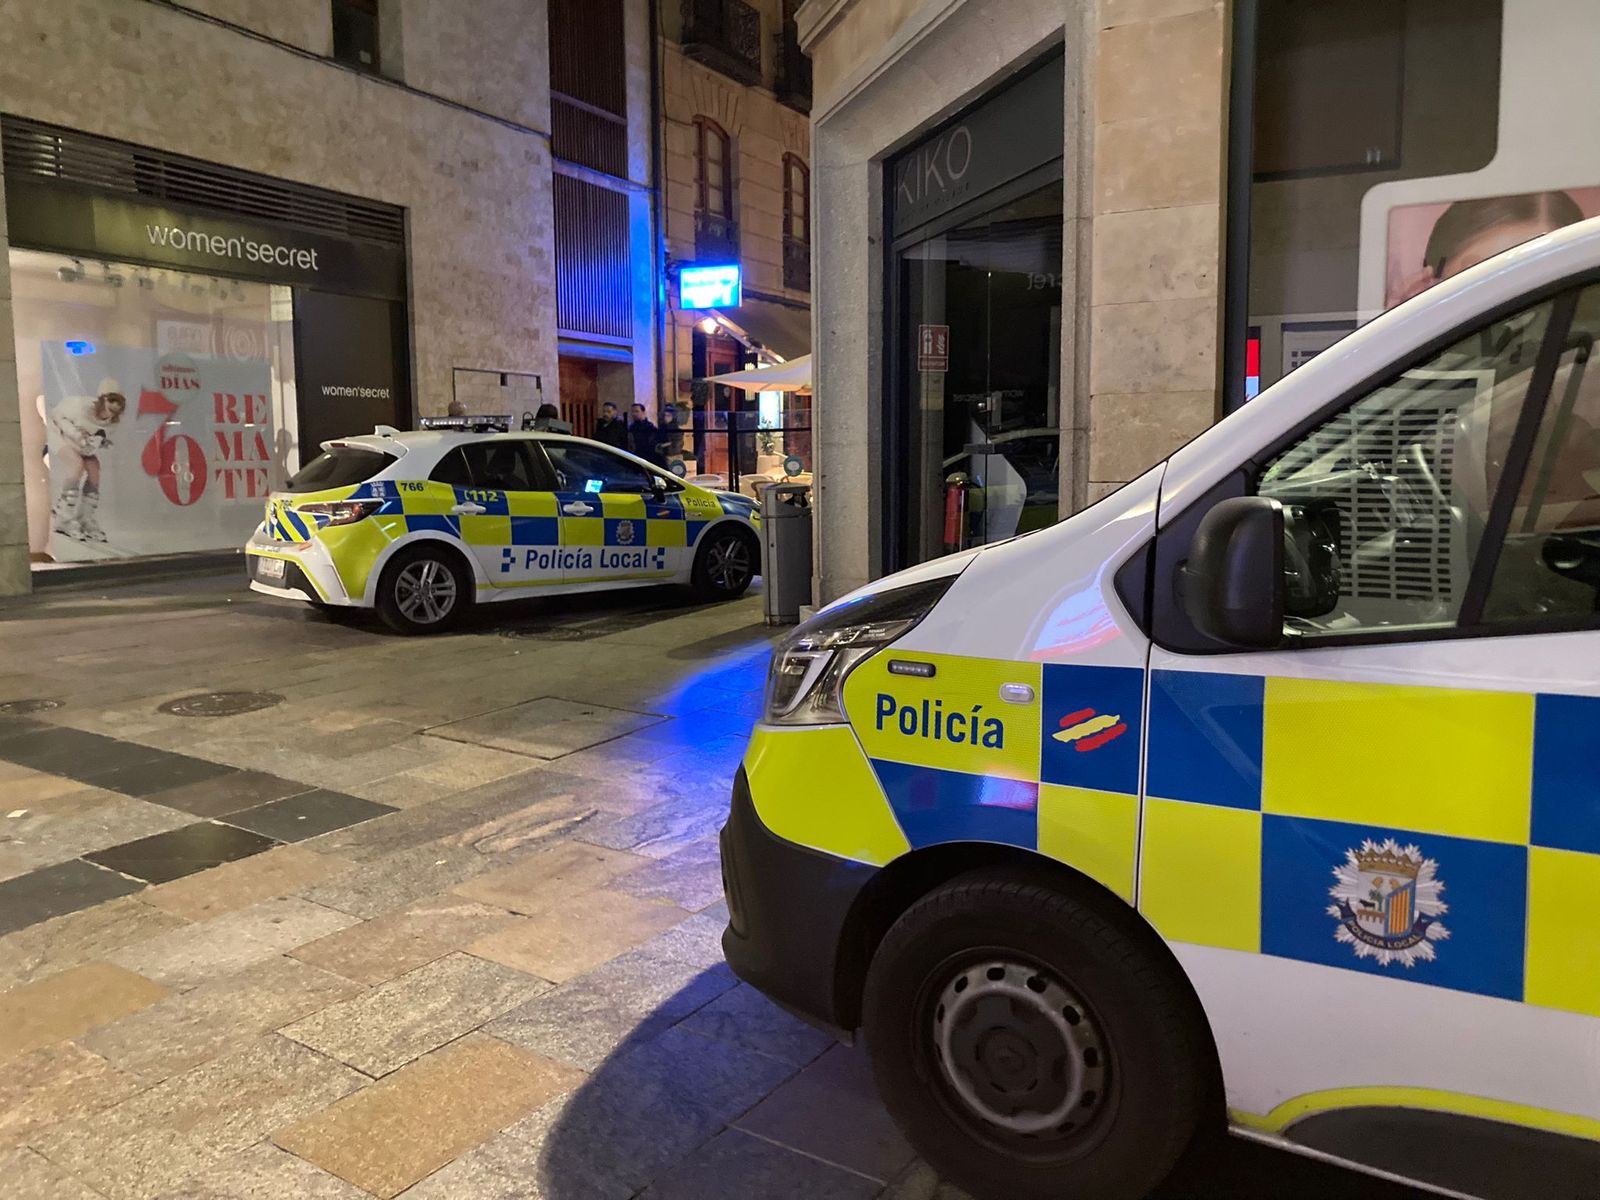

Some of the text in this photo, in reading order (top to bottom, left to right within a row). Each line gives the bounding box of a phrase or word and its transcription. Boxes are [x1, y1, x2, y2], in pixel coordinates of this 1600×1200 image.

[897, 126, 971, 207] KIKO
[146, 224, 319, 271] women'secret
[321, 385, 390, 399] women'secret
[213, 392, 268, 425] RE
[214, 431, 271, 461] MA
[215, 468, 271, 499] TE
[400, 482, 424, 492] 766
[471, 489, 499, 502] 112
[525, 547, 649, 570] Policía Local
[876, 693, 1005, 749] Policía
